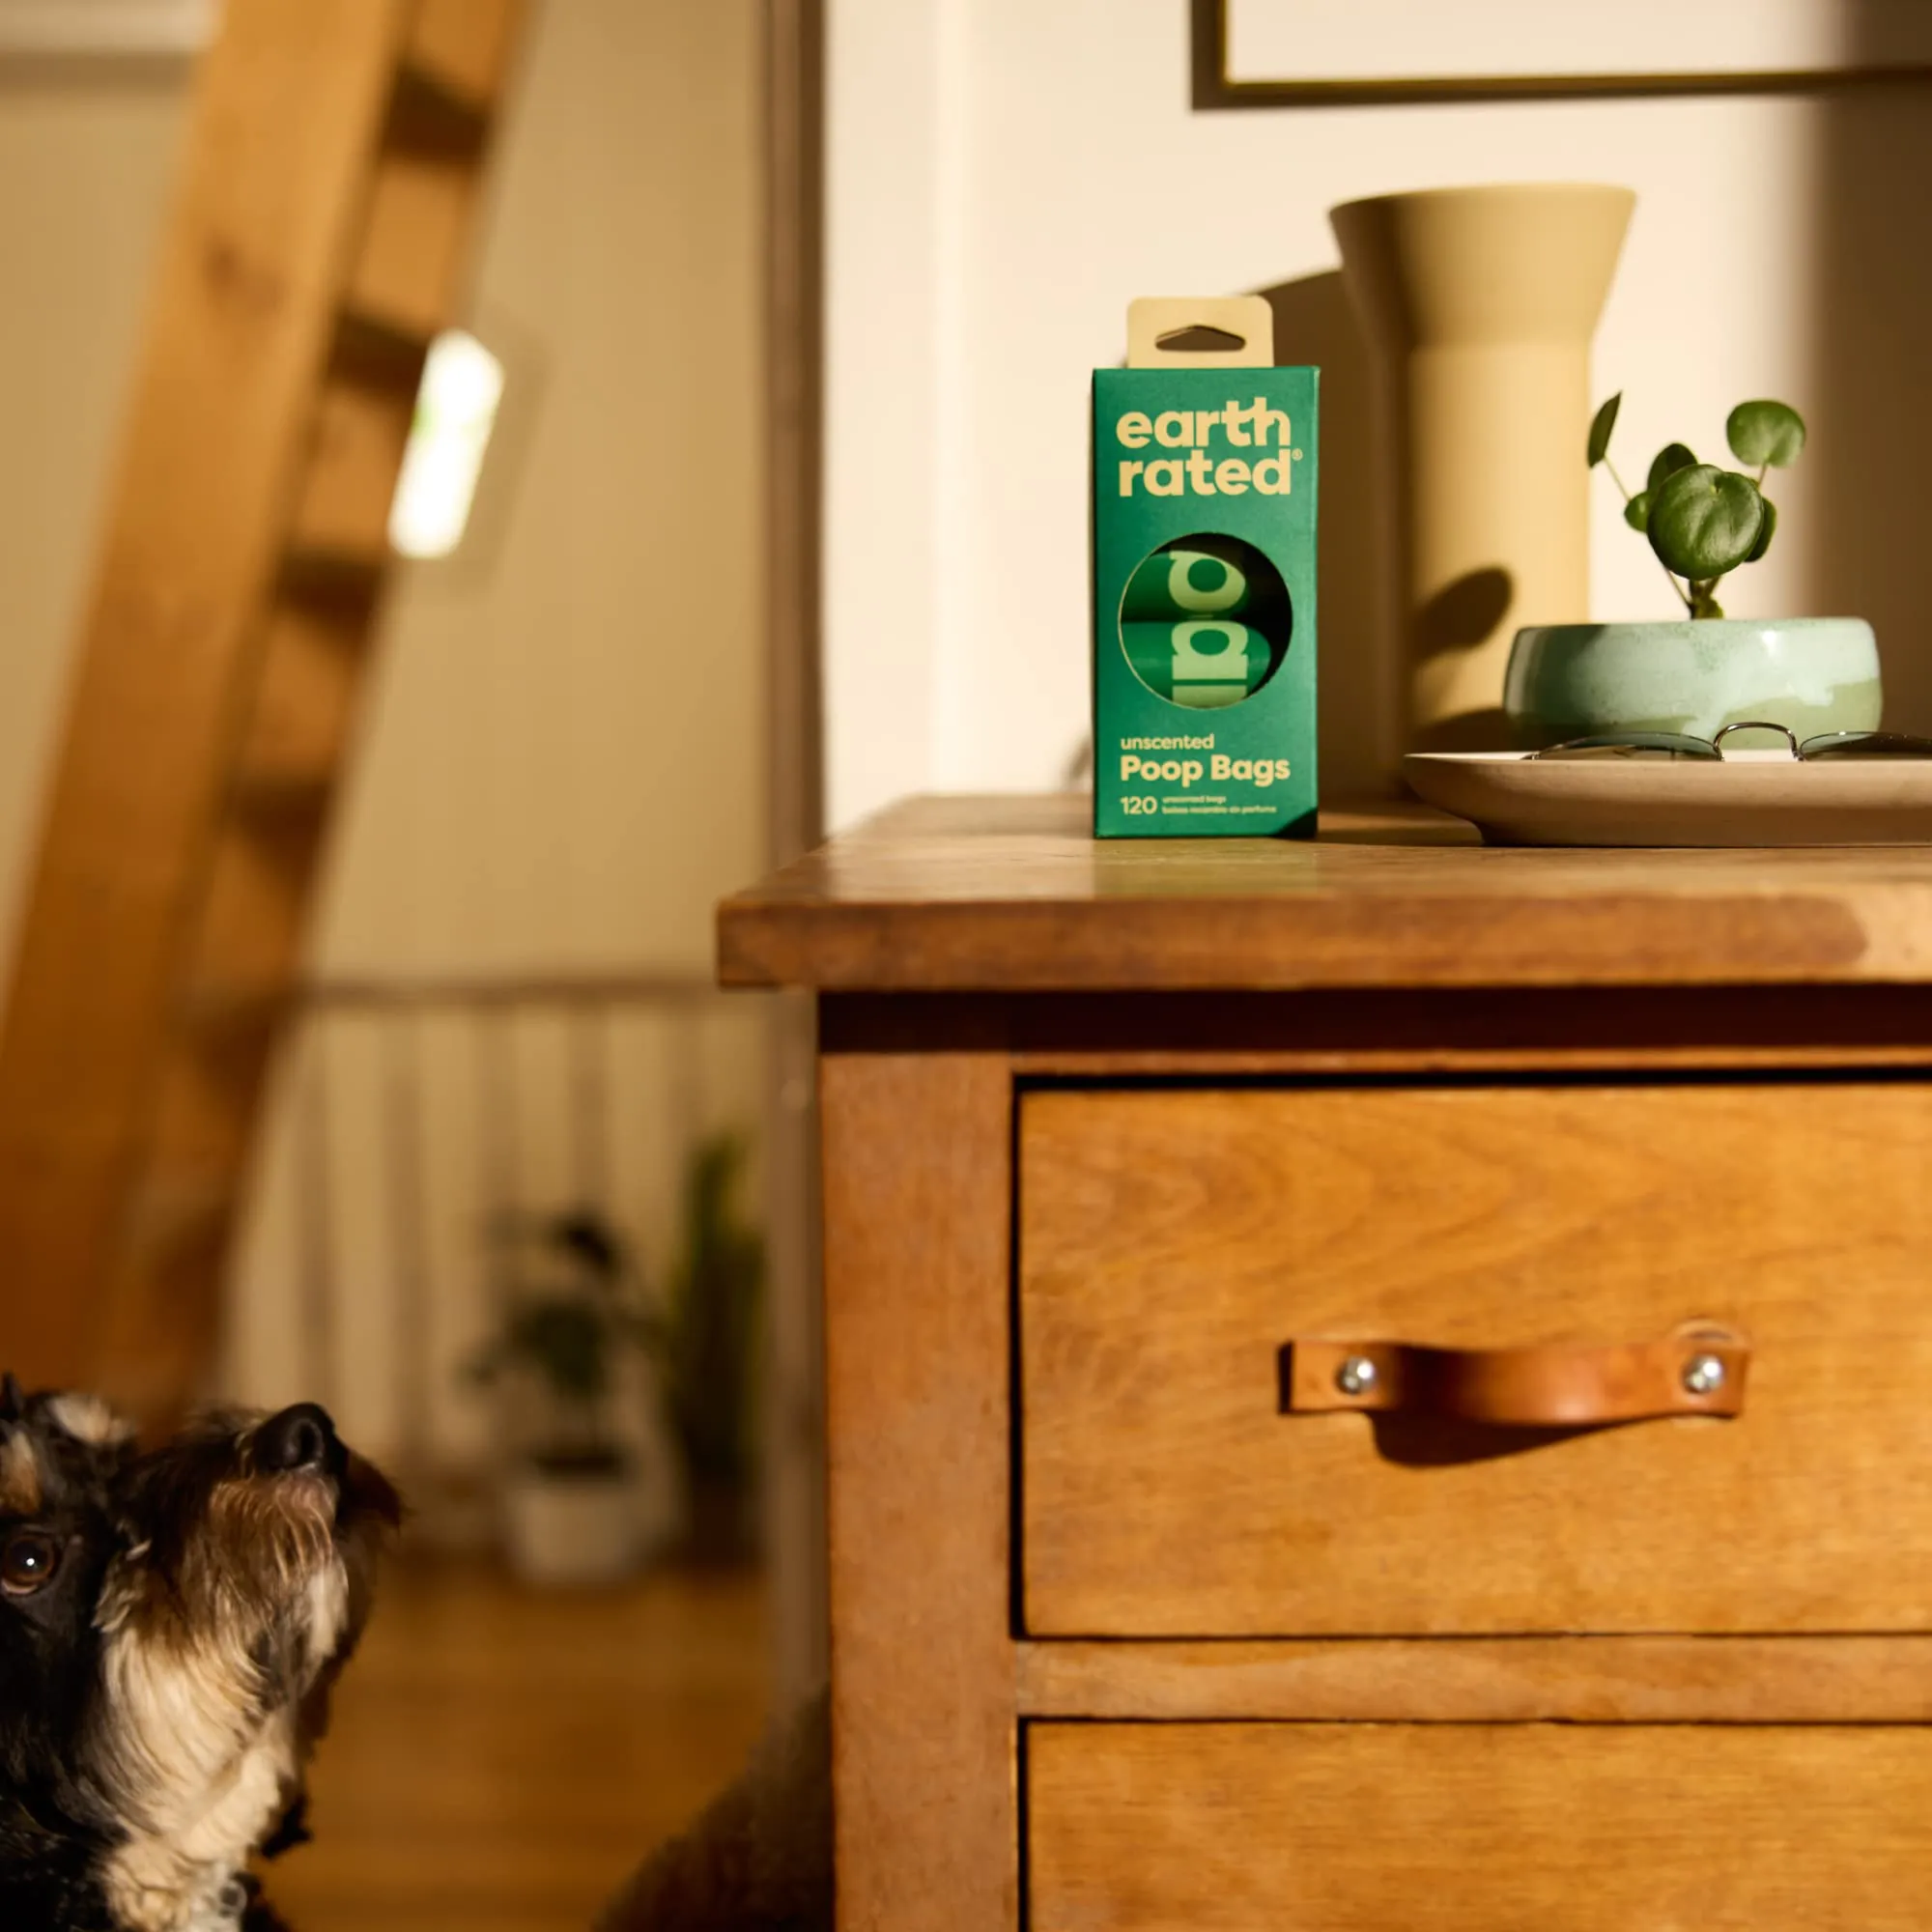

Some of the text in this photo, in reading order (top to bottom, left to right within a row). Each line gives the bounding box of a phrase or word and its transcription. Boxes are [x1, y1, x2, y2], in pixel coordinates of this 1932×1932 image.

[1116, 396, 1292, 448] earth
[1121, 733, 1215, 751] unscented
[1121, 753, 1292, 788] Poop Bags
[1121, 796, 1158, 815] 120
